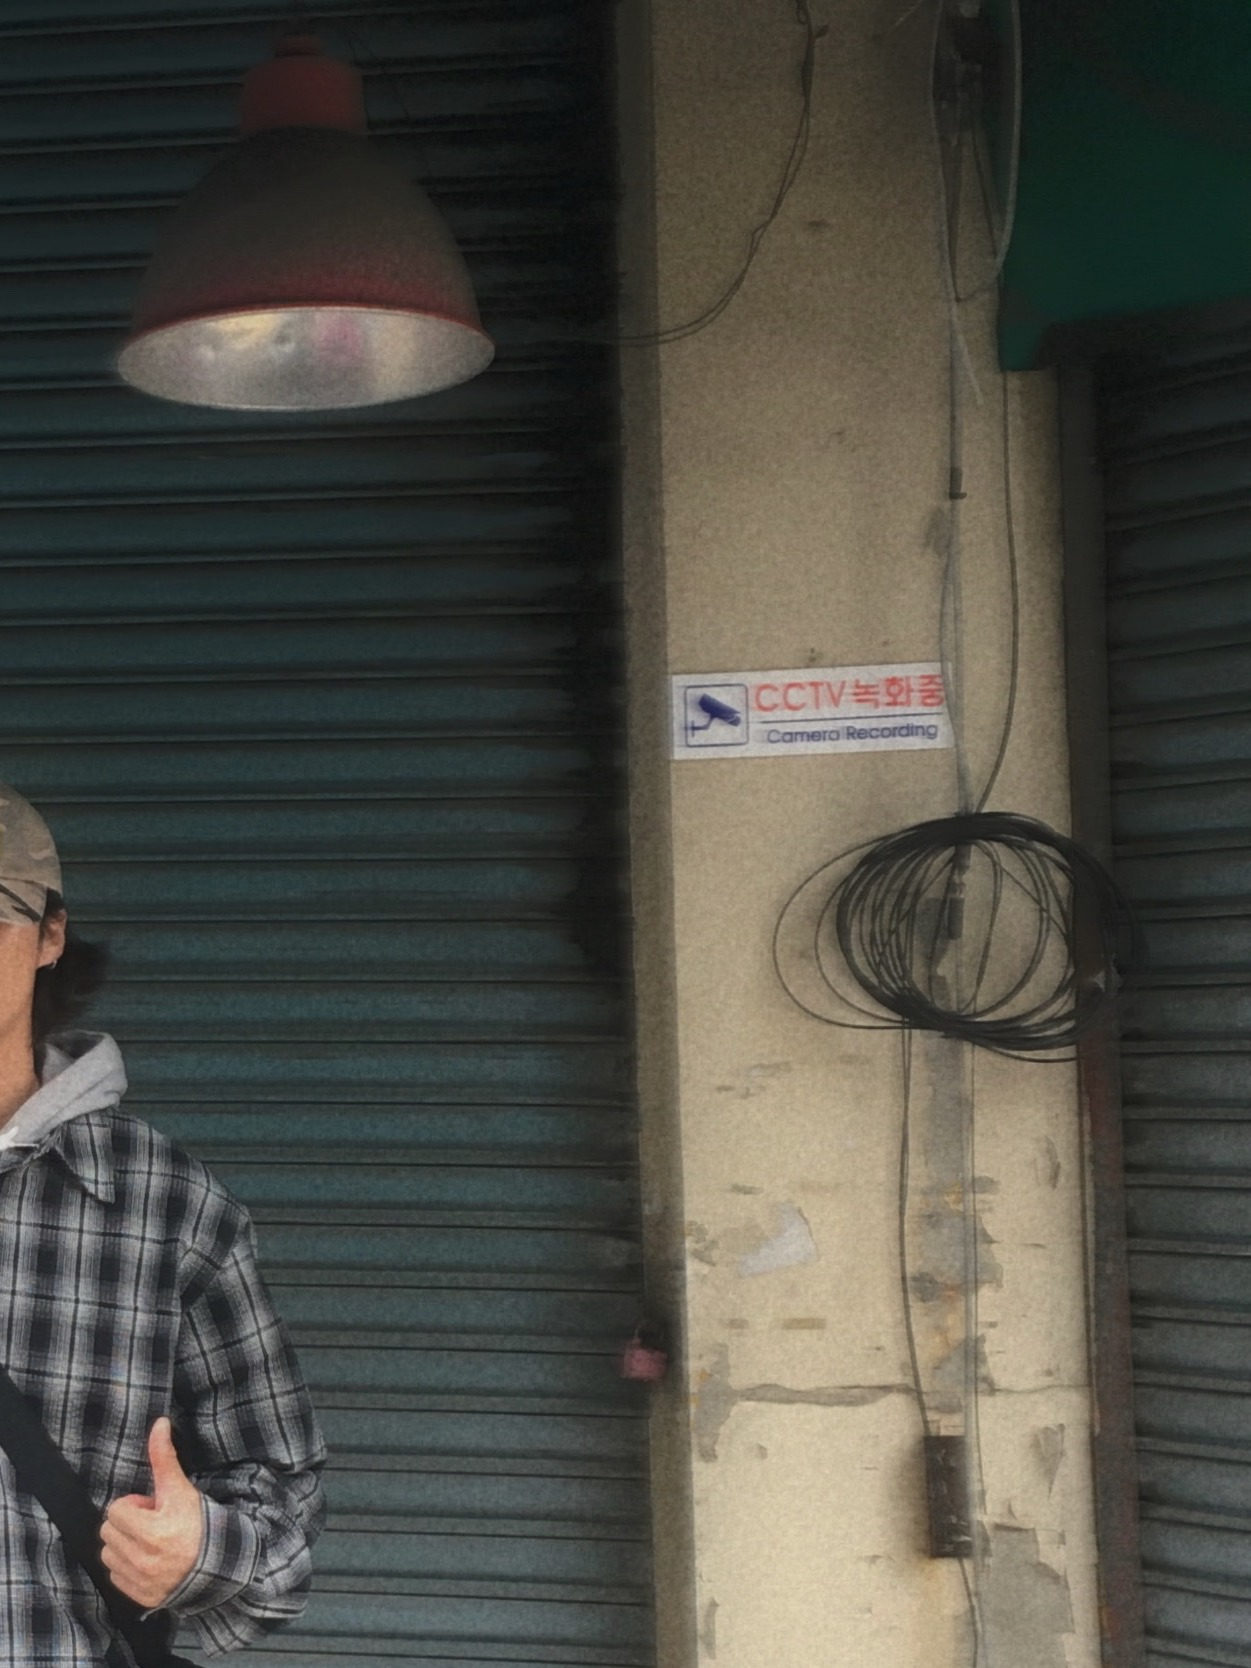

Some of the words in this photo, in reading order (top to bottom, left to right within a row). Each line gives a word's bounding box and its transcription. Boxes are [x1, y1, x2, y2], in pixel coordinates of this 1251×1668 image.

[755, 680, 847, 712] CCTV
[852, 674, 944, 709] 녹화중
[767, 728, 840, 744] Camera
[846, 723, 938, 740] Recording
